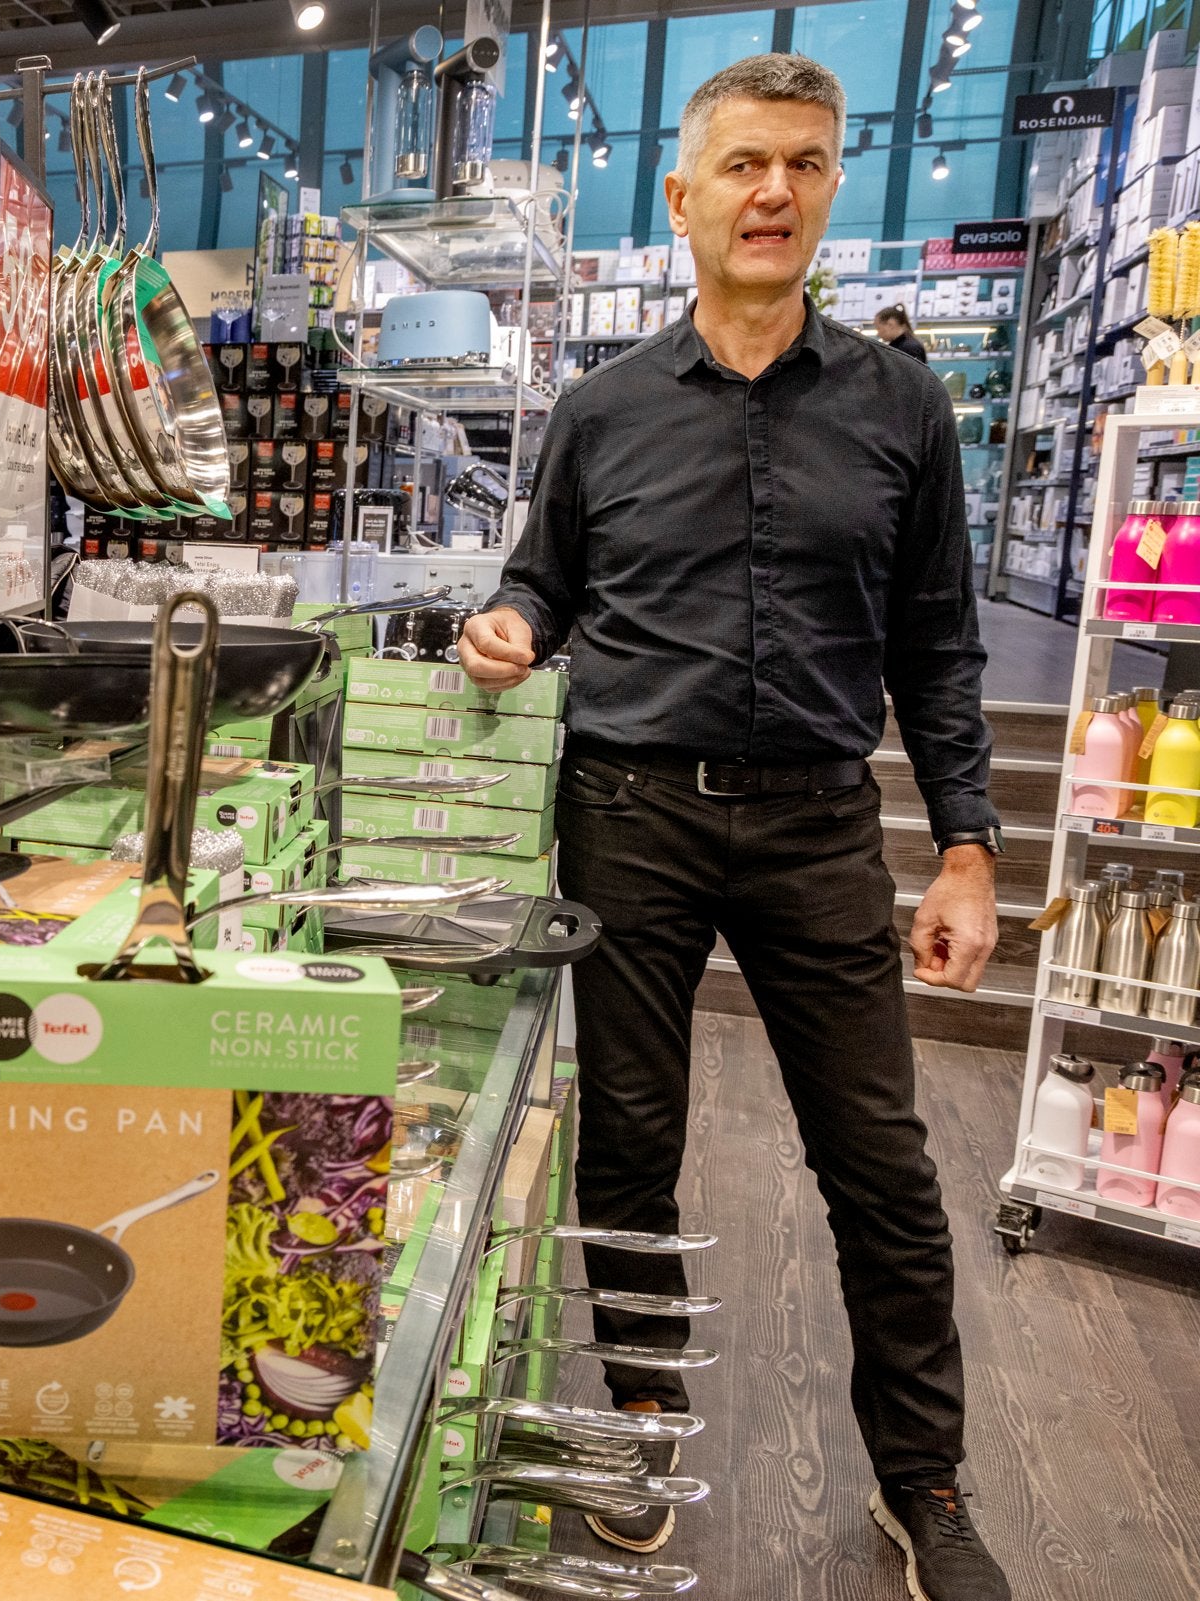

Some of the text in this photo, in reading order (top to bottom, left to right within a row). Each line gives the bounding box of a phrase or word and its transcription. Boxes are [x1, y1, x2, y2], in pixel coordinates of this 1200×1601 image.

[1018, 113, 1105, 130] ROSENDAHL
[1096, 823, 1120, 834] 40%
[42, 1022, 90, 1036] Tefal
[210, 1010, 362, 1039] CERAMIC
[209, 1036, 360, 1062] NON-STICK
[117, 1108, 204, 1136] PAN
[291, 1457, 330, 1481] Tefal
